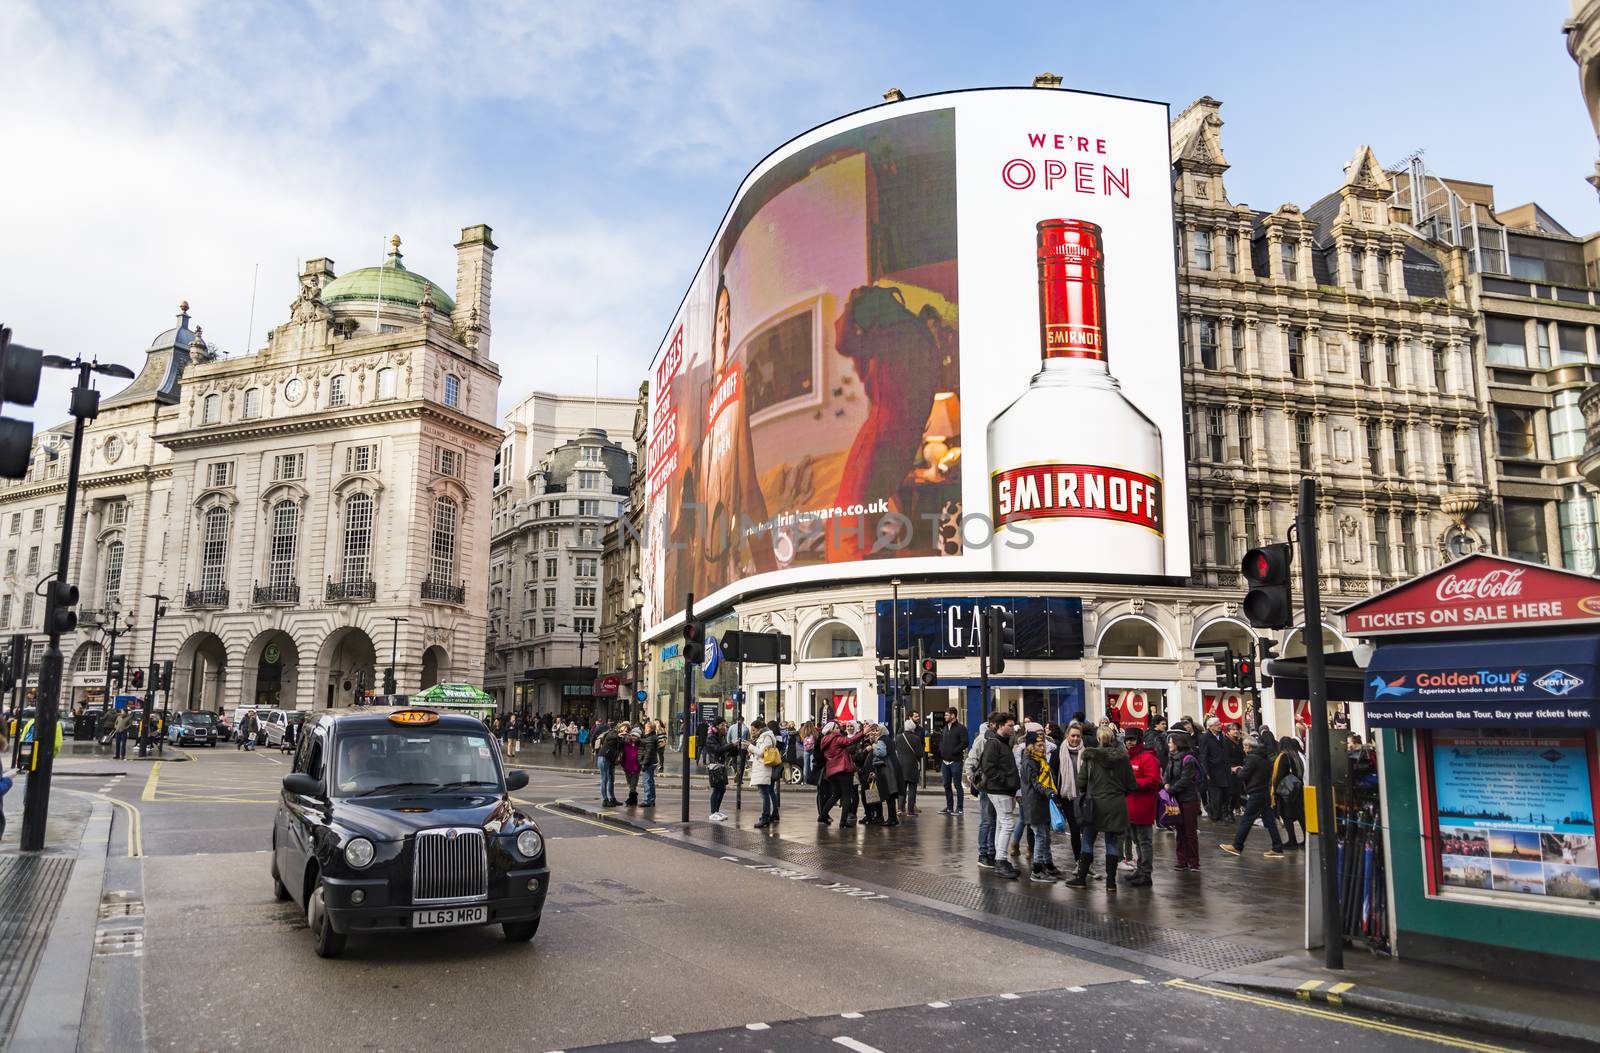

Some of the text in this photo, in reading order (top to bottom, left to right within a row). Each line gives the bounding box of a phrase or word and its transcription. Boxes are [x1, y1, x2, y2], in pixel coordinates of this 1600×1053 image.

[1028, 133, 1106, 154] WE'RE
[1002, 159, 1130, 199] OPEN
[656, 332, 682, 400] LABELS
[709, 371, 737, 424] SMIRNOFF
[648, 411, 677, 477] BOTTLES
[662, 451, 677, 483] PEOPLE
[1436, 568, 1526, 601] Coca-Cola
[1358, 602, 1562, 628] TICKETS ON SALE HERE
[1416, 669, 1527, 687] GoldenTours
[1419, 687, 1455, 695] Experience
[400, 713, 431, 721] TAXI
[1366, 708, 1591, 720] Hop-on Hop-off London Bus Tour, Buy your tickets here.
[1502, 739, 1536, 747] TICKETS
[418, 908, 482, 925] LL63 MRO
